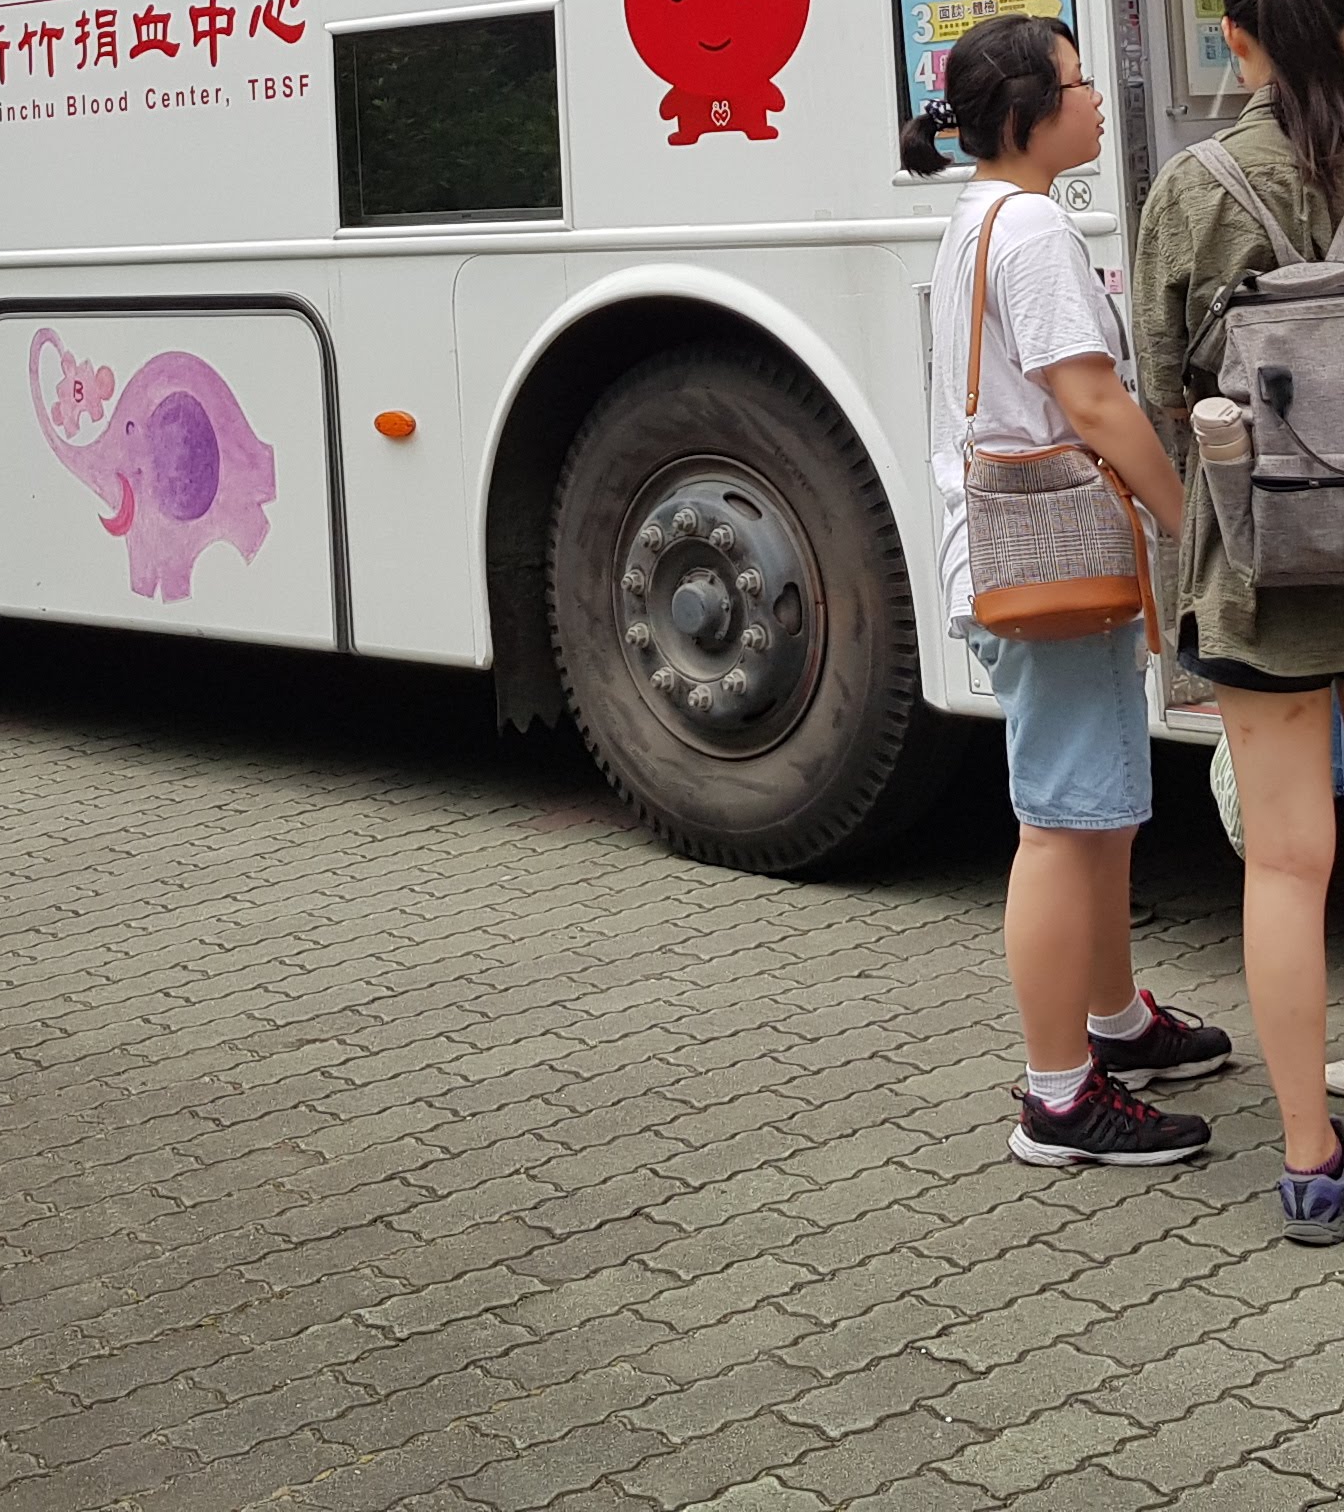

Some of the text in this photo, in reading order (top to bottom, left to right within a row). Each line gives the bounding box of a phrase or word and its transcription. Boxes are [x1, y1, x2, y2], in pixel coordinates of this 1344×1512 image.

[911, 3, 934, 43] 3
[915, 50, 936, 91] 4
[67, 91, 128, 116] Blood
[145, 85, 231, 110] Center,
[248, 74, 310, 101] TBSF
[73, 380, 84, 403] B
